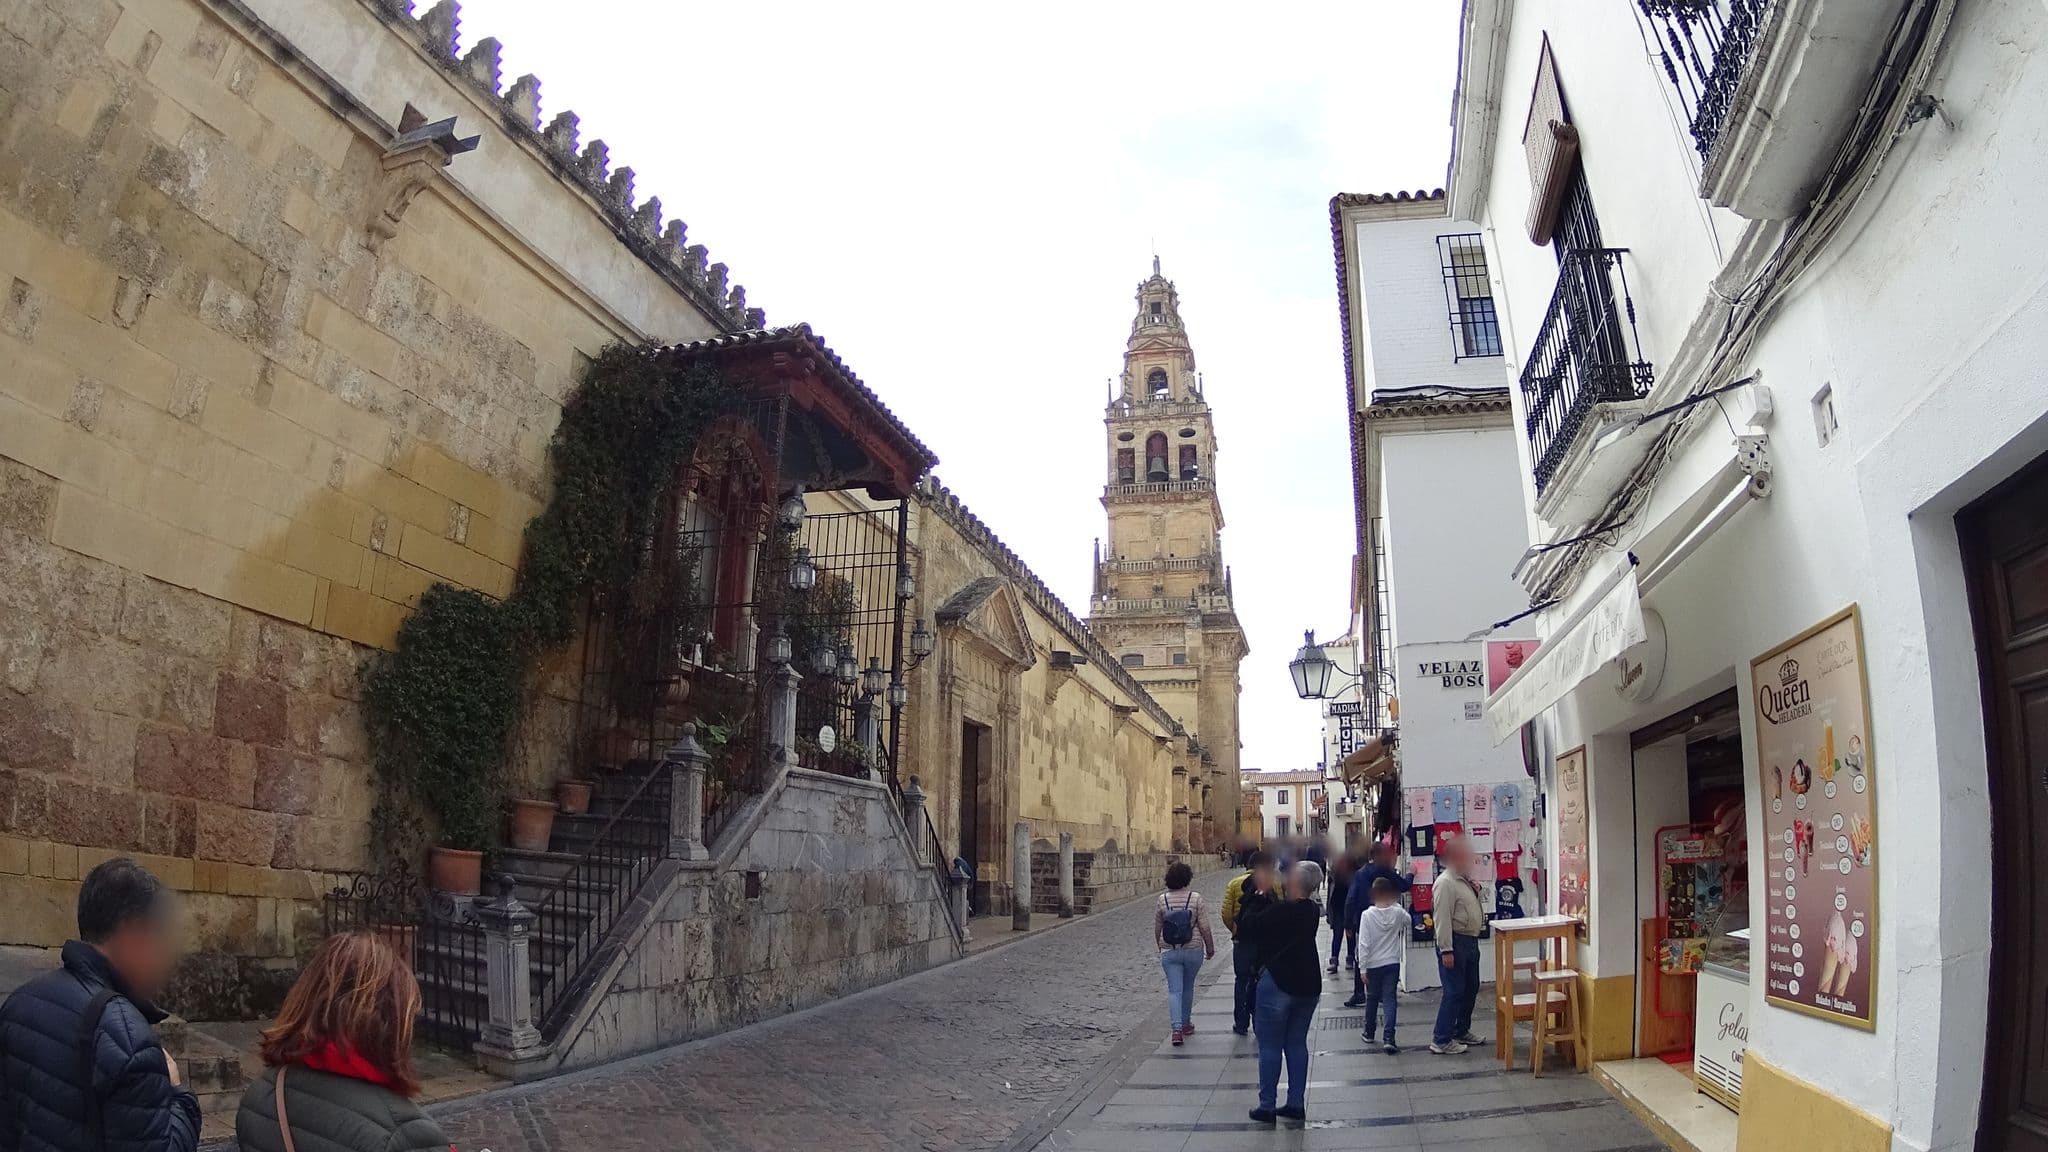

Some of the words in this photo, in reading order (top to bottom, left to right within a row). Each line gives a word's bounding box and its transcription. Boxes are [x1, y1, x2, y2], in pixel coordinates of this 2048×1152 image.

[1419, 660, 1483, 675] VELAZ
[1331, 703, 1360, 714] MARISA
[1759, 679, 1811, 725] Queen
